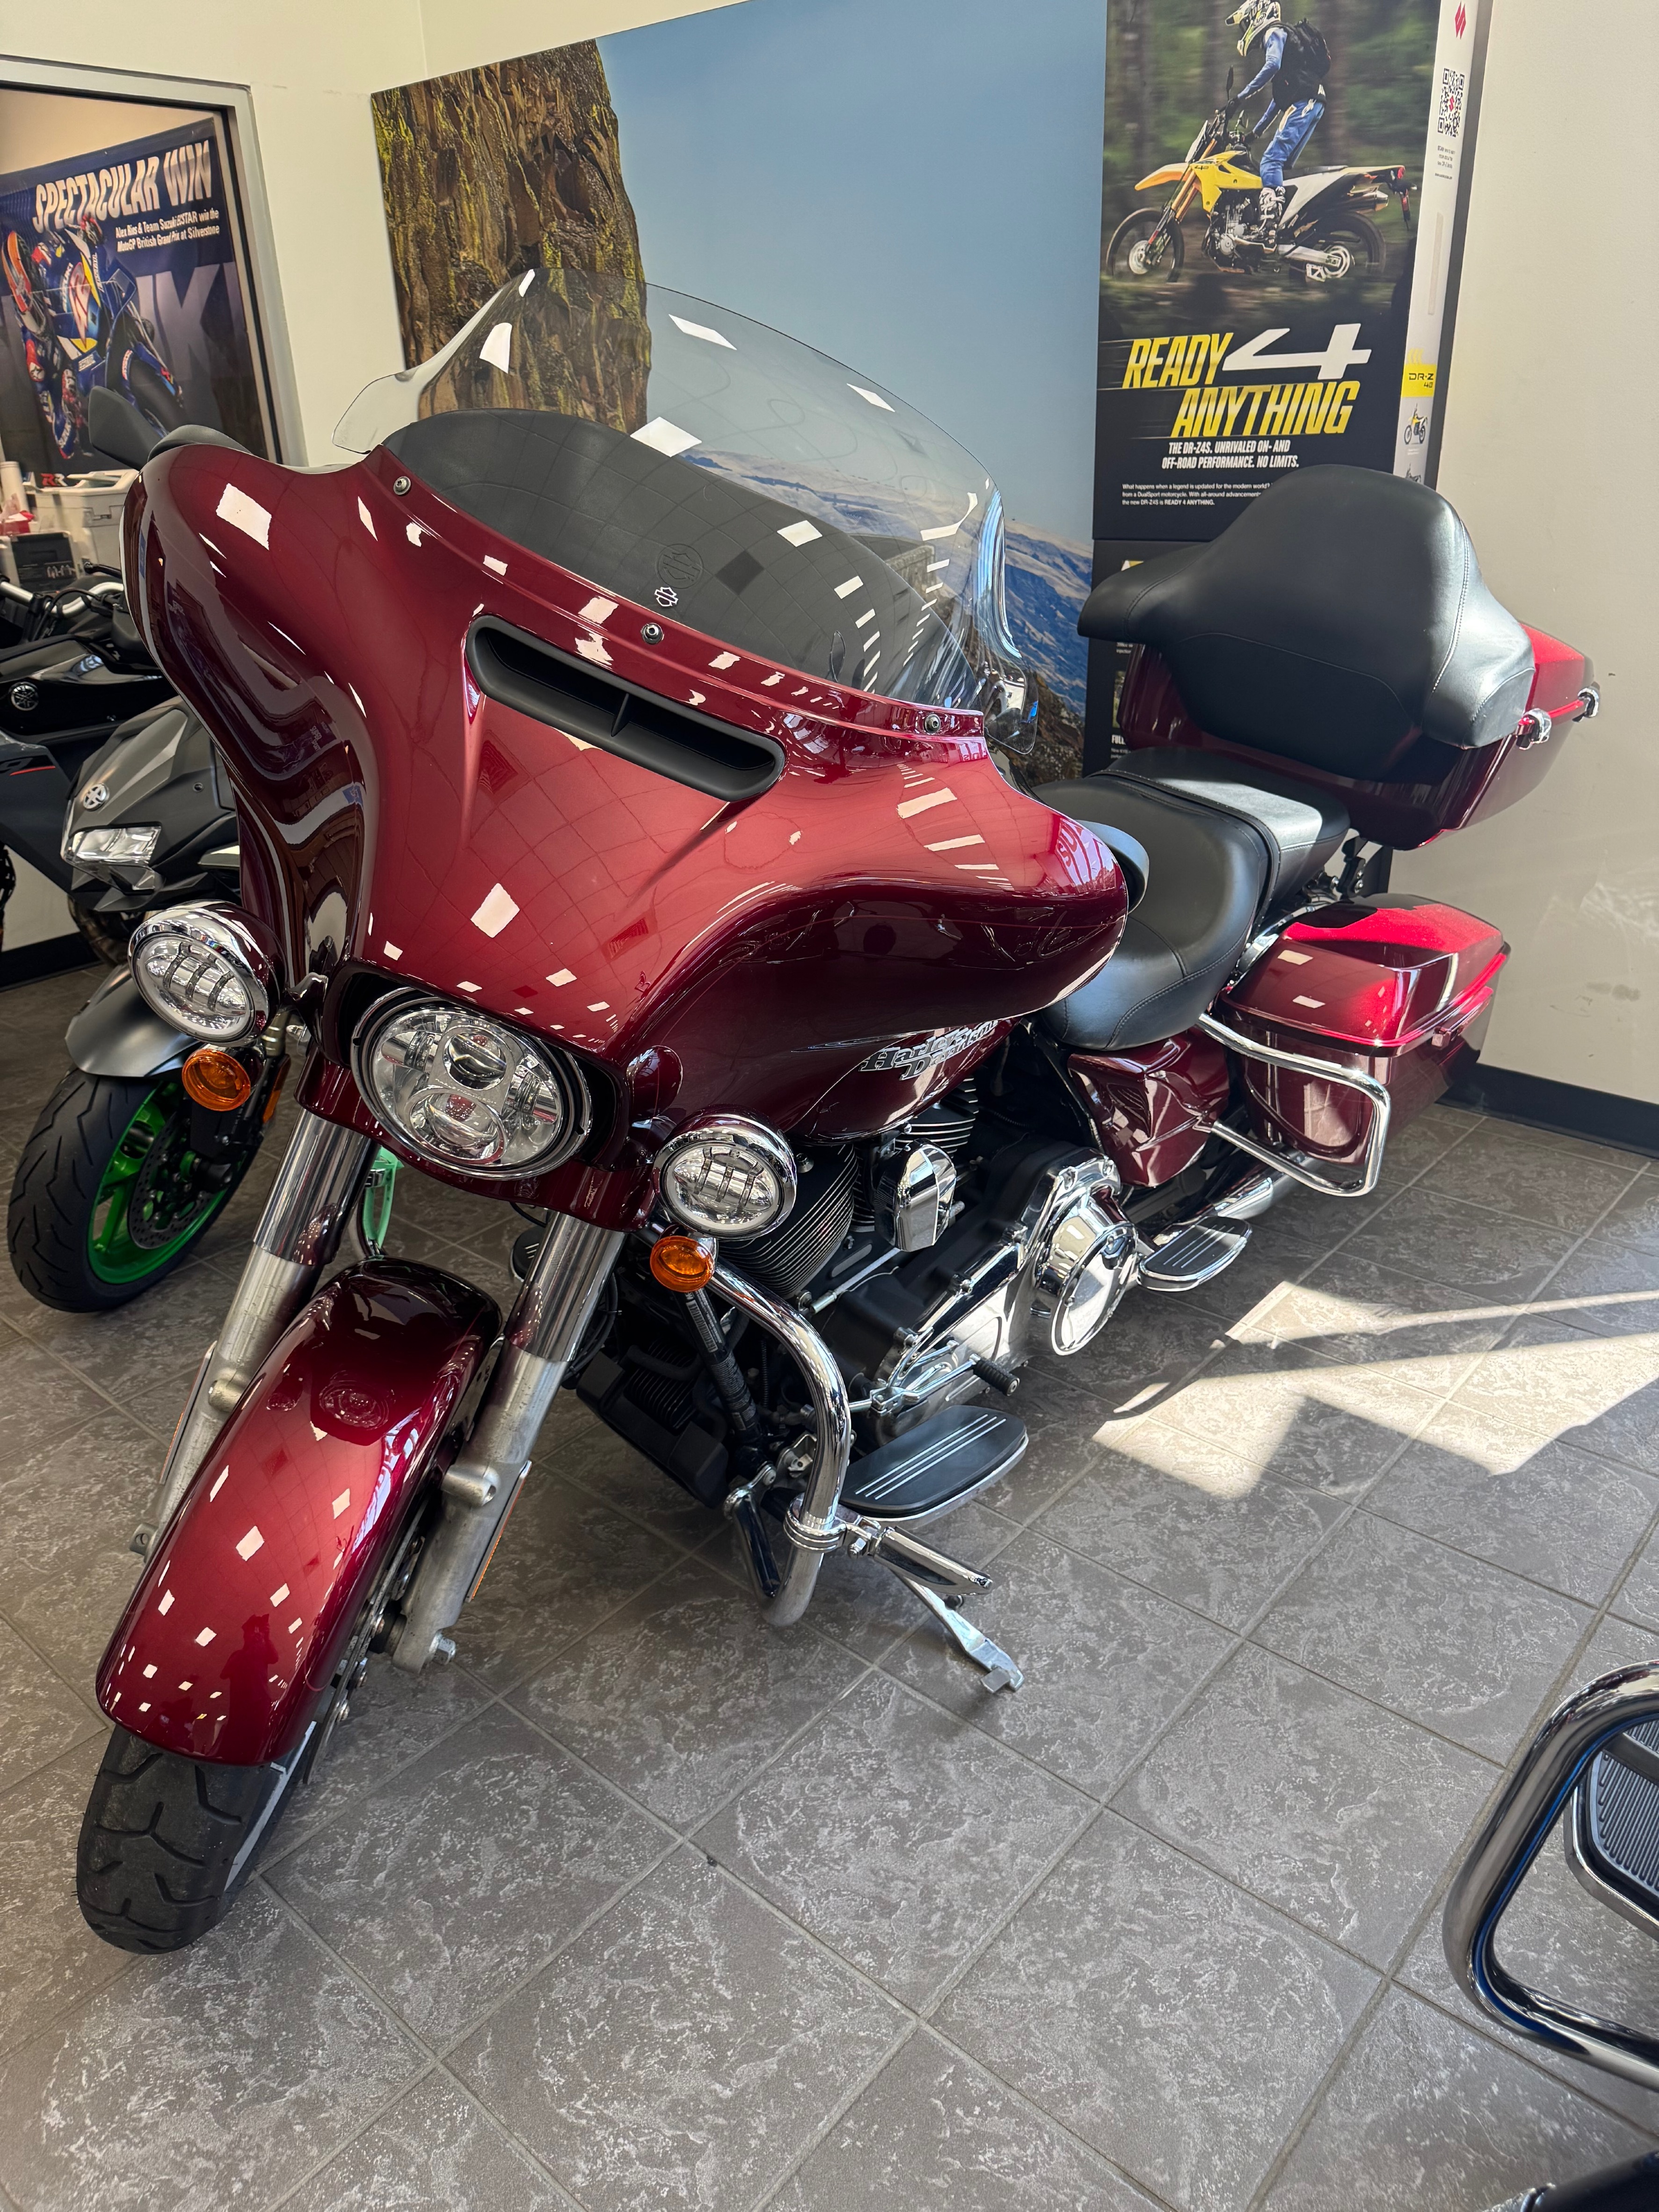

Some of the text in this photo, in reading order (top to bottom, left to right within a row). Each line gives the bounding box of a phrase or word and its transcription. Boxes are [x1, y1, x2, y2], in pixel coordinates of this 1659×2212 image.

[32, 140, 211, 233] SPECTACULAR WIN
[143, 221, 160, 233] Team
[159, 216, 177, 231] Suzuki
[198, 209, 210, 222] win
[210, 207, 219, 219] the
[136, 235, 157, 248] British
[180, 230, 187, 240] at
[188, 225, 220, 239] Silverstone
[1122, 323, 1372, 389] READY 4
[1171, 381, 1361, 438] ANYTHING
[1169, 440, 1291, 454] THE DR-Z4S. UNRIVALED ON- AND
[1162, 455, 1299, 469] OFF-ROAD PERFORMANCE. NO LIMITS.
